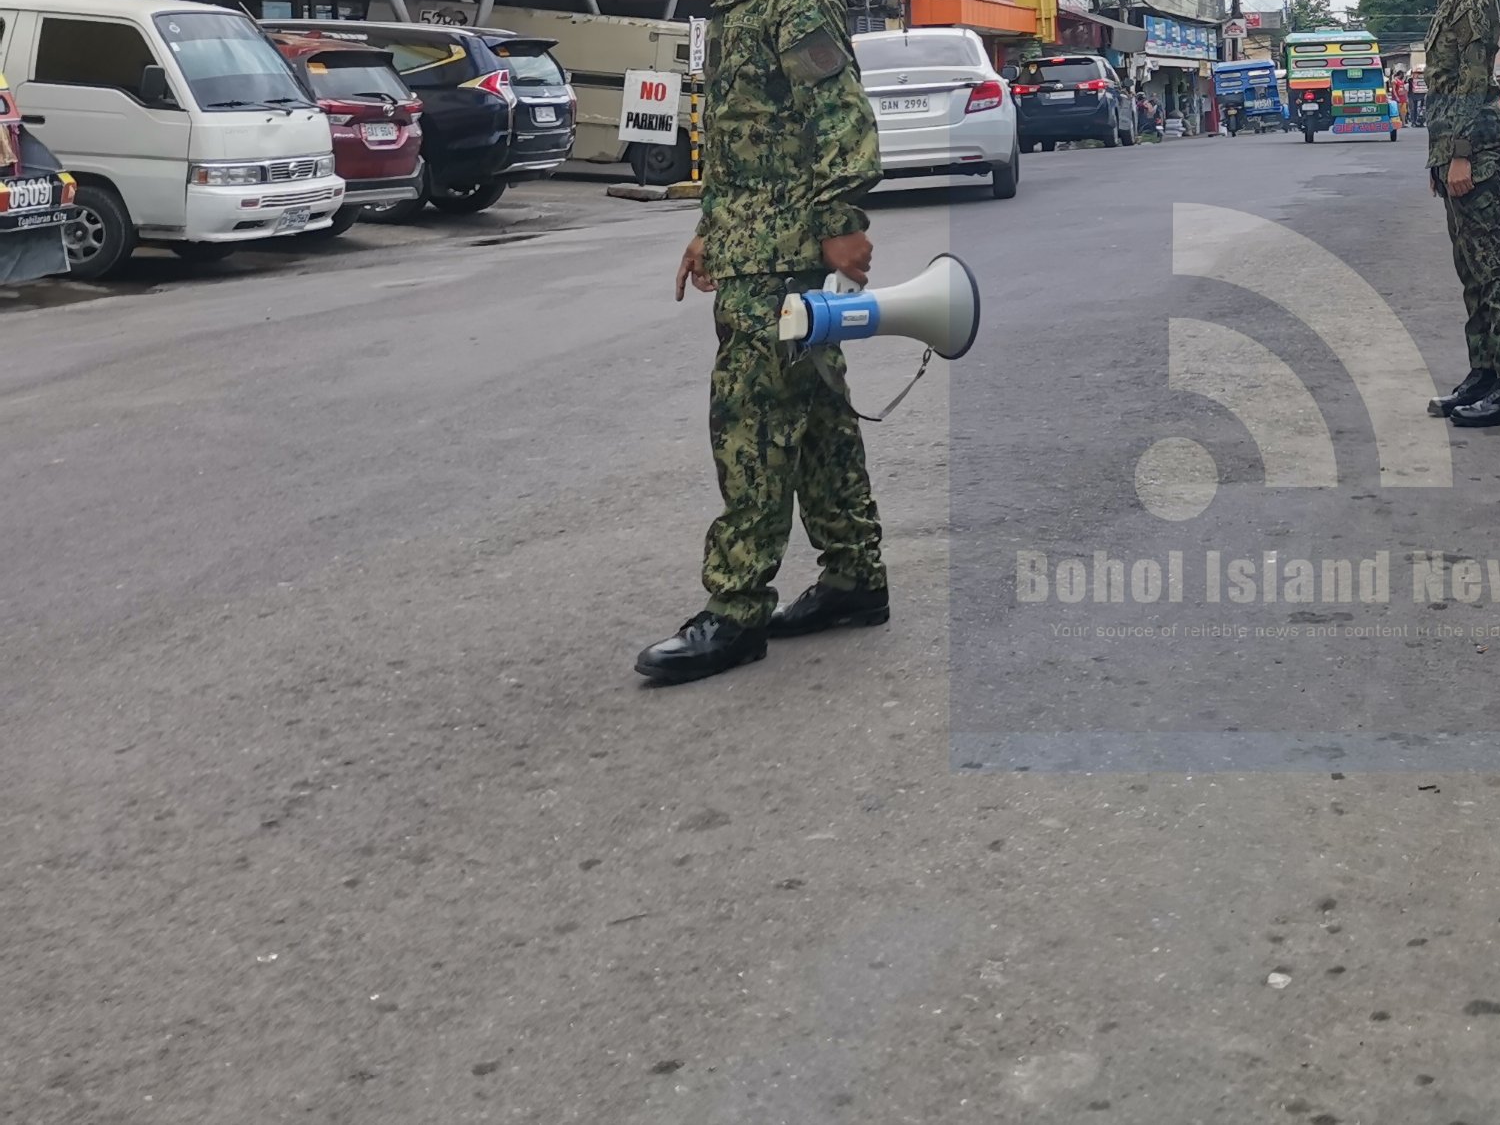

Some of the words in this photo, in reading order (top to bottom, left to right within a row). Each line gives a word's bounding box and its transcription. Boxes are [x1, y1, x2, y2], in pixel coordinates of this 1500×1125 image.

[640, 81, 666, 101] NO
[881, 98, 899, 111] GAN
[904, 96, 928, 109] 2996
[626, 112, 673, 132] PARKING
[53, 211, 67, 222] City
